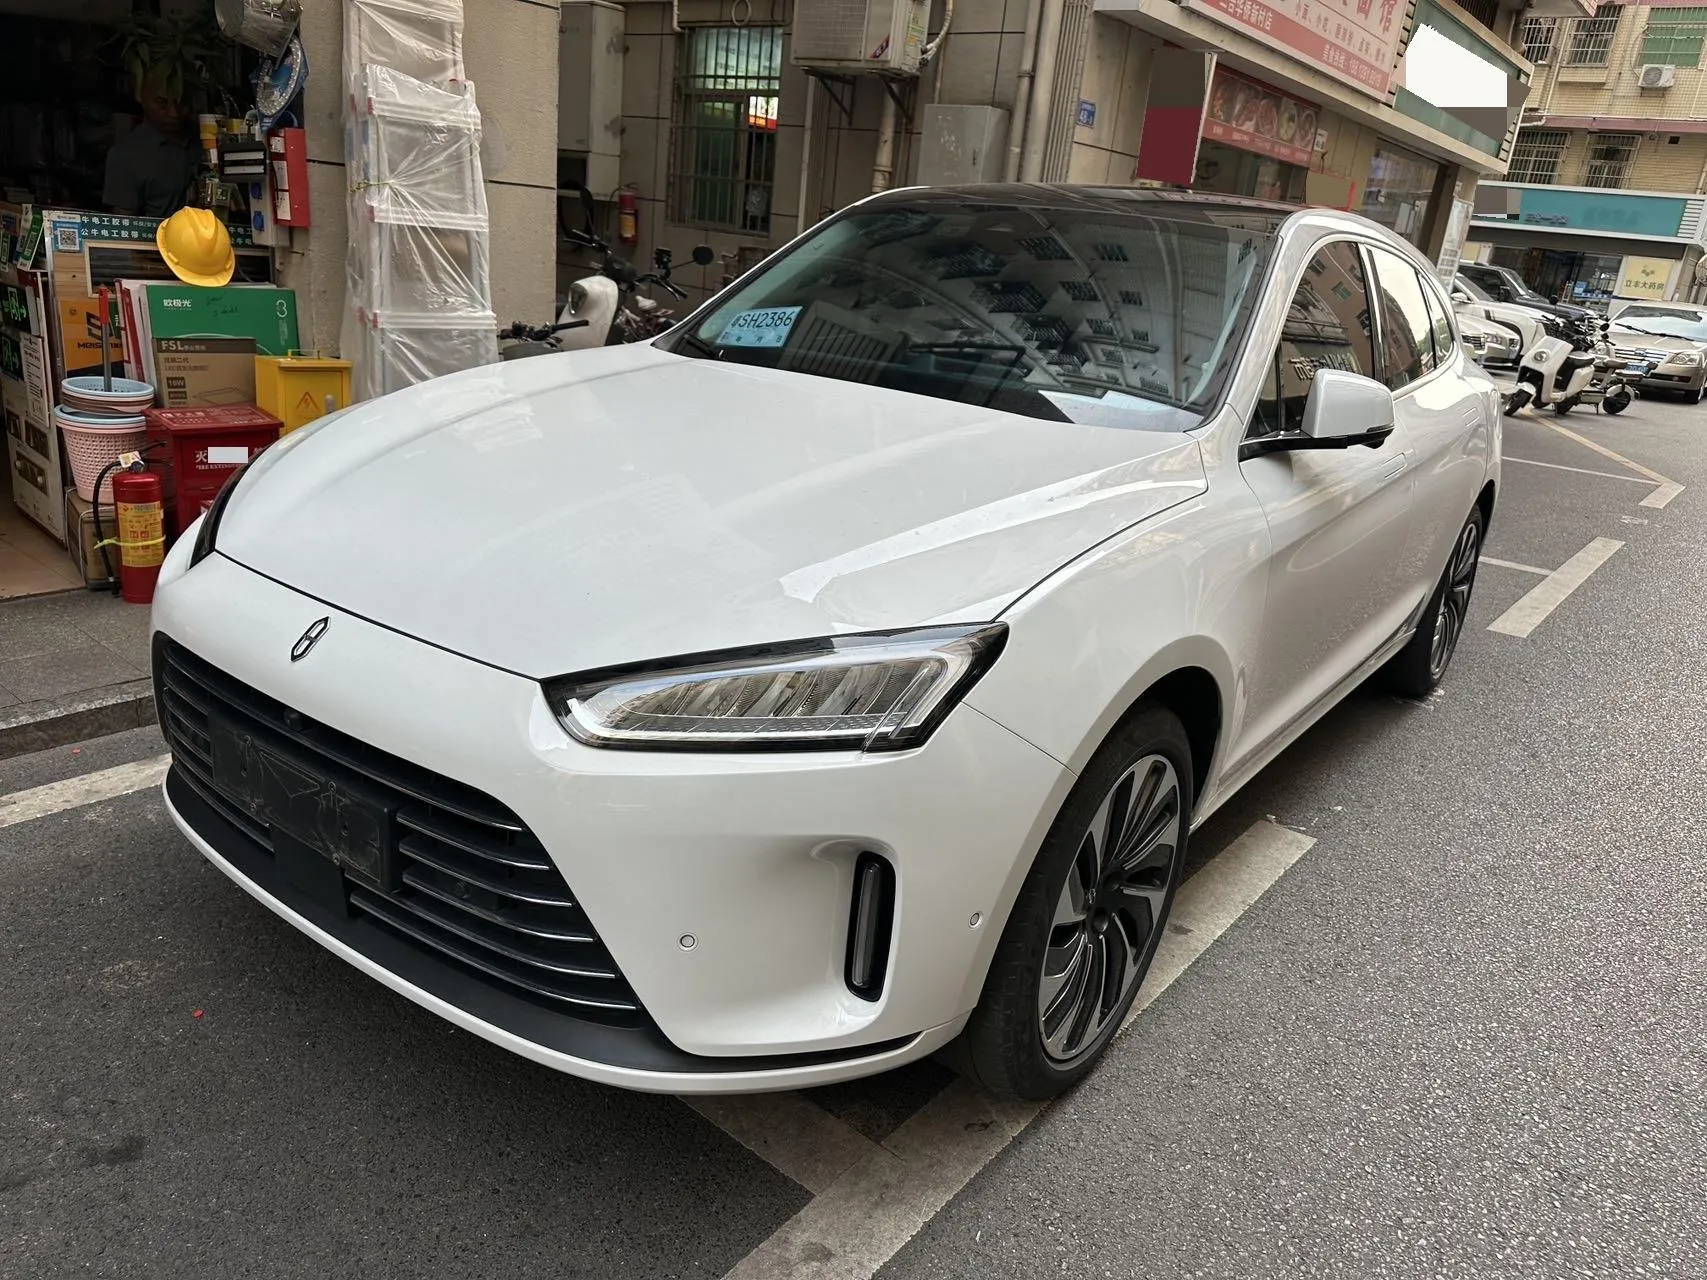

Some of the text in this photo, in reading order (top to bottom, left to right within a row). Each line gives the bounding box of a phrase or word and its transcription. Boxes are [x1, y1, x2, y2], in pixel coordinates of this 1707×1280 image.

[1219, 0, 1273, 30] 华侨新村店
[81, 216, 130, 226] 牛电工胶带
[81, 228, 139, 239] 公牛电工胶带
[163, 298, 192, 307] 欧极光
[161, 340, 184, 351] FSL
